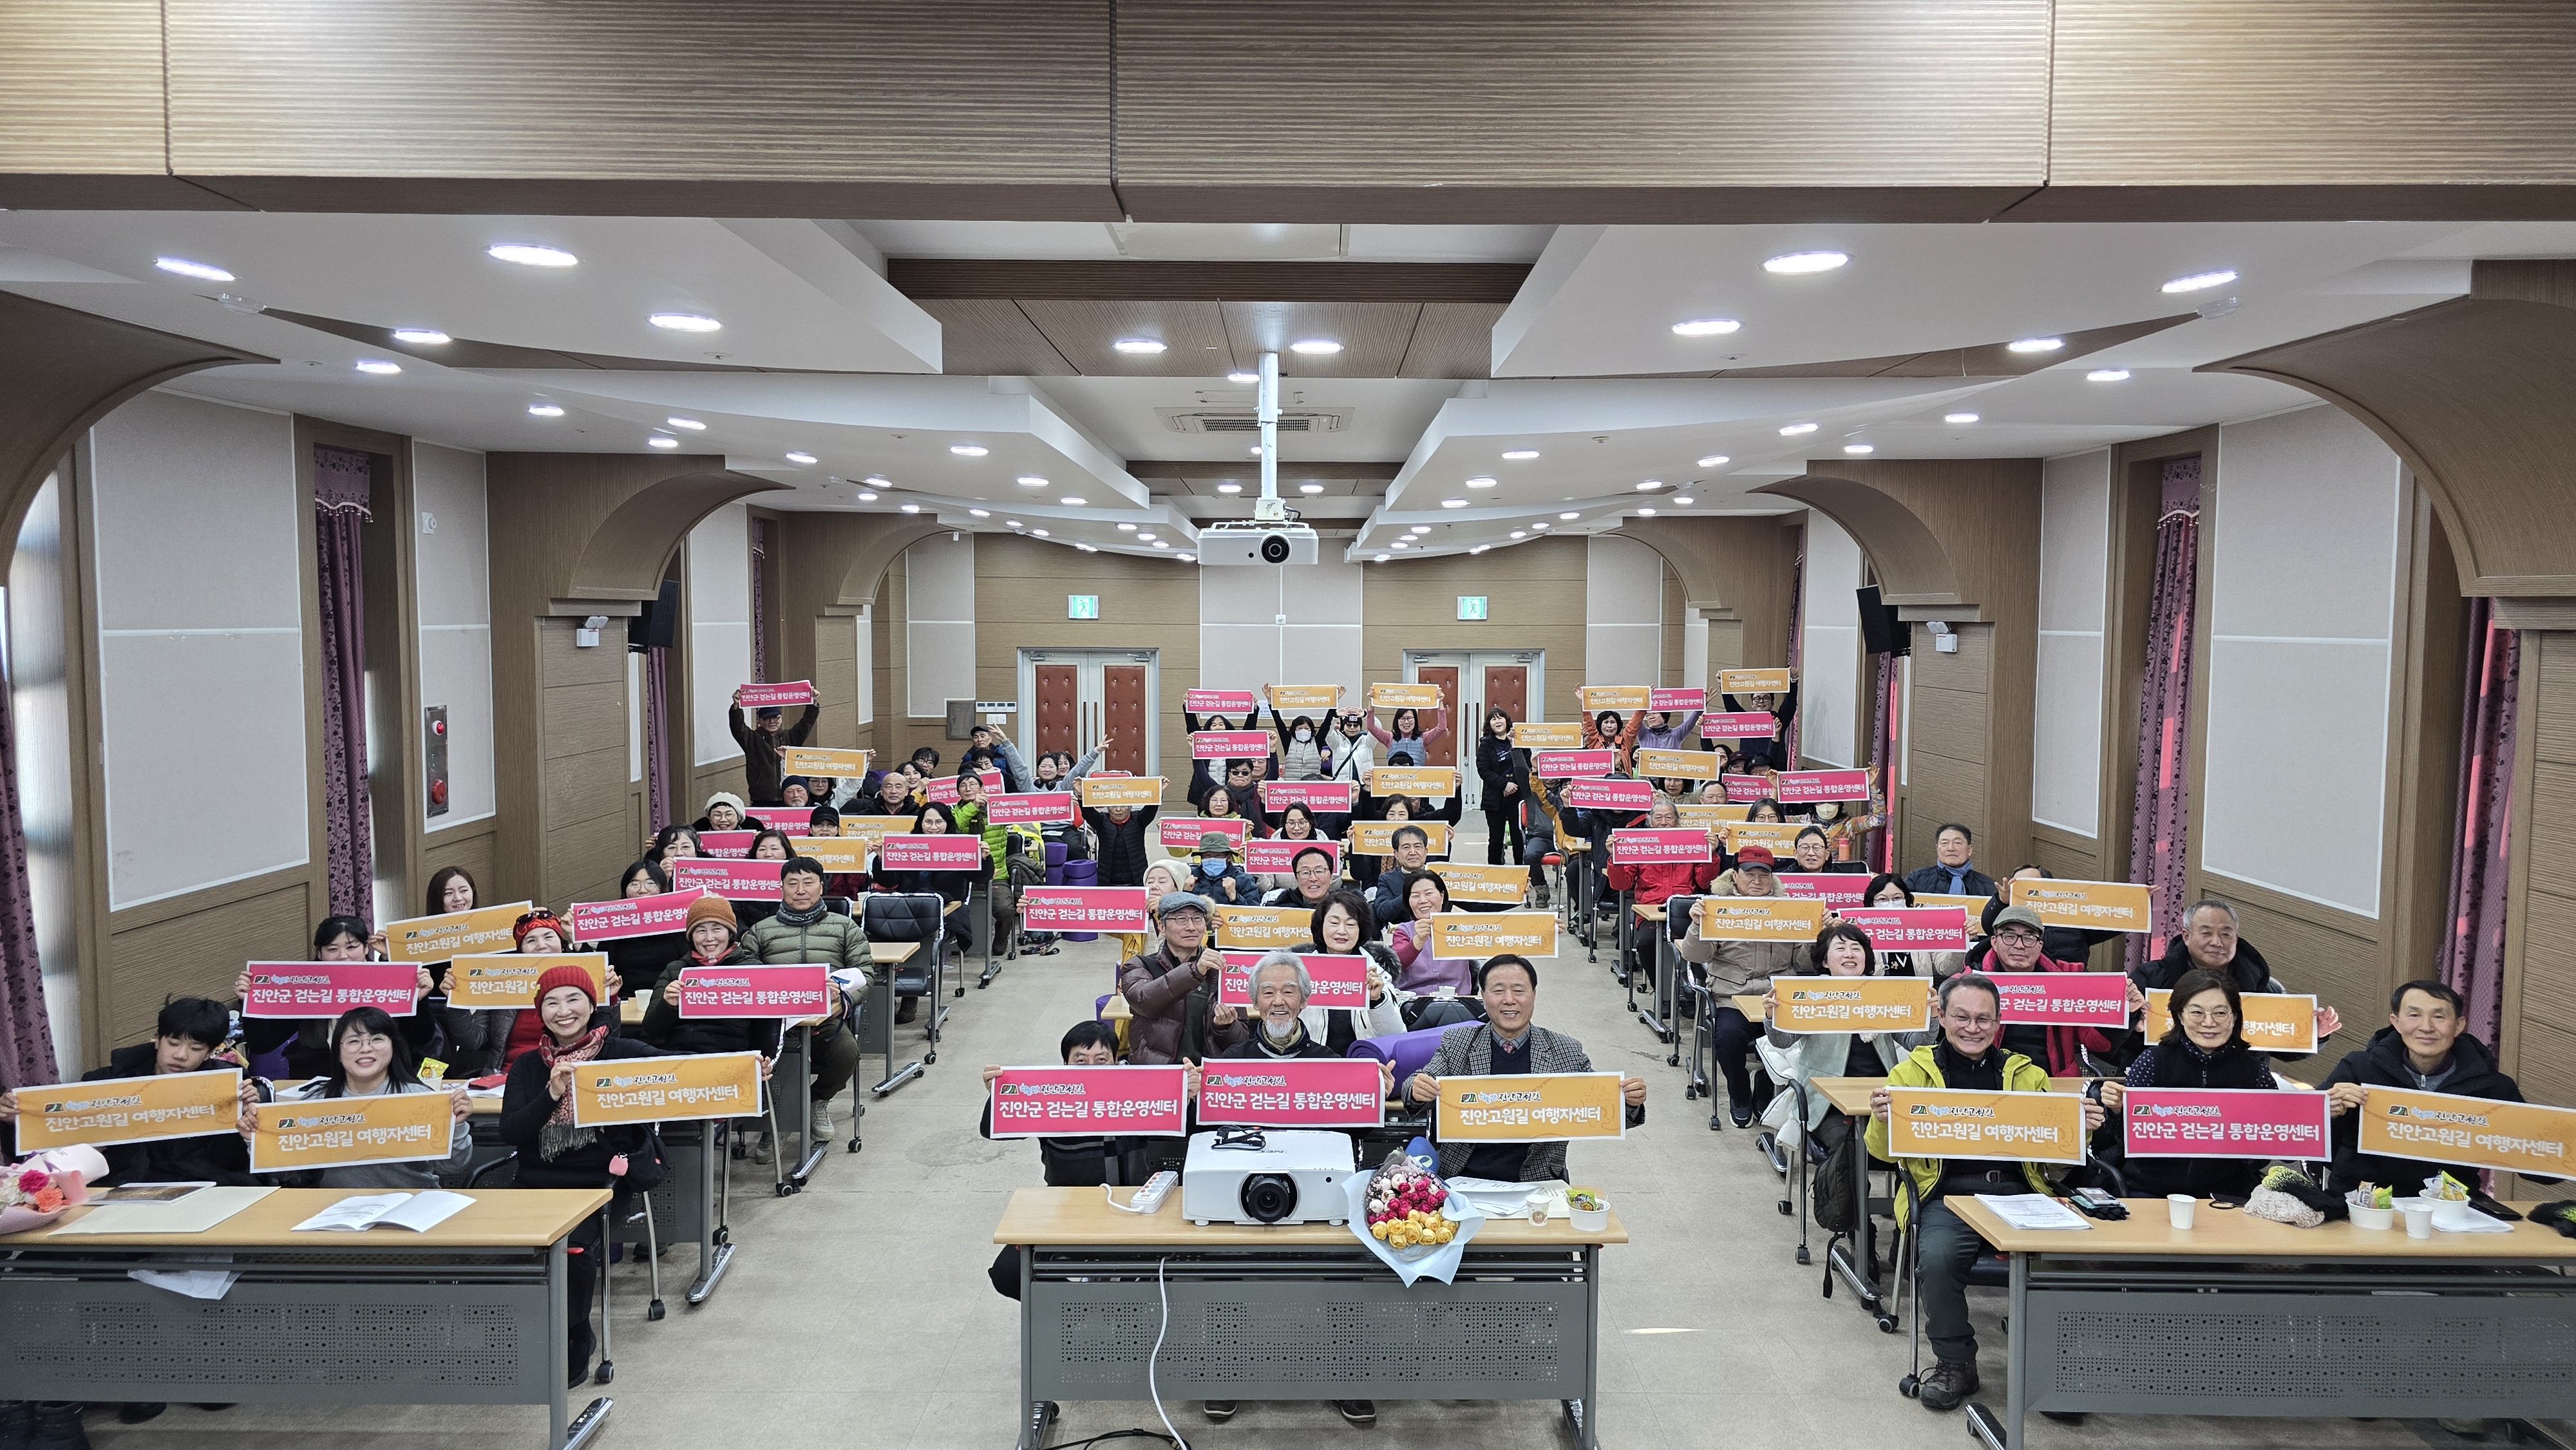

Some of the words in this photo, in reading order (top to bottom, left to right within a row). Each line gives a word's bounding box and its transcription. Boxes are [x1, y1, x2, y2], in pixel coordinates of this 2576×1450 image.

[794, 761, 824, 769] 진안고원길
[1648, 762, 1678, 771] 진안고원길
[930, 791, 948, 800] 진안군
[1092, 791, 1121, 799] 진안고원길
[1781, 786, 1801, 795] 진안군
[1803, 786, 1822, 795] 걷는길
[1823, 784, 1865, 794] 통합운영센터
[1269, 796, 1288, 804] 진안군
[1309, 796, 1347, 804] 통합운영센터
[1571, 791, 1591, 800] 진안군
[1592, 793, 1611, 801] 걷는길
[1611, 794, 1651, 802] 통합운영센터
[990, 807, 1010, 817] 진안군
[1012, 807, 1030, 816] 걷는길
[1031, 805, 1069, 815] 통합운영센터
[774, 822, 810, 831] 통합운영센
[1162, 831, 1182, 839] 진안군
[1364, 838, 1391, 846] 진안고원
[1616, 845, 1639, 855] 진안군
[1640, 845, 1662, 854] 걷는길
[1663, 844, 1707, 854] 통합운영센터
[817, 854, 855, 863] 여행자센터
[886, 852, 908, 861] 진안군
[910, 852, 931, 861] 걷는길
[933, 852, 976, 862] 통합운영센터
[1249, 856, 1269, 865] 진안군
[1271, 856, 1291, 866] 걷는길
[679, 878, 704, 889] 진안군
[706, 879, 730, 890] 걷는길
[1446, 881, 1476, 892] 안고원길
[1477, 882, 1517, 894] 여행자센터
[1028, 908, 1056, 920] 진안군
[1059, 909, 1084, 920] 걷는길
[1087, 909, 1143, 921] 통합운영센터
[2080, 905, 2132, 919] 여행자센터
[577, 917, 609, 931] 진안군
[611, 913, 640, 927] 걷는길
[643, 909, 688, 923] 통합운영
[1714, 918, 1763, 929] 진안고원길
[1763, 919, 1812, 930] 여행자센터
[1229, 927, 1271, 937] 진안고원길
[1876, 928, 1904, 941] 걷는길
[1905, 928, 1963, 941] 통합운영센터
[406, 936, 460, 955] 진안고원길
[1445, 935, 1492, 946] 진안고원길
[1495, 935, 1541, 946] 여행자센터
[469, 979, 529, 994] 진안고원길
[1225, 978, 1249, 992] 진안
[1311, 981, 1362, 995] 합운영센터
[251, 988, 292, 1004] 진안군
[295, 988, 333, 1004] 걷는길
[336, 988, 412, 1003] 통합운영센터
[685, 991, 719, 1004] 진안군
[721, 991, 753, 1004] 걷는길
[755, 990, 823, 1004] 통합운영센터
[1791, 1005, 1849, 1019] 진안고원길
[1852, 1005, 1911, 1019] 여행자센터
[2013, 998, 2047, 1012] 걷는길
[2050, 998, 2121, 1014] 통합운영센터
[2244, 1021, 2295, 1036] 행자센터
[596, 1089, 665, 1109] 진안고원길
[667, 1085, 738, 1104] 여행자센터
[1205, 1091, 1247, 1109] 진안군
[1250, 1092, 1289, 1111] 걷는길
[1293, 1091, 1376, 1111] 통합운영센터
[998, 1100, 1044, 1119] 진안군
[1046, 1100, 1088, 1119] 걷는길
[1092, 1099, 1177, 1118] 통합운영센터
[44, 1111, 128, 1133] 진안고원길
[132, 1104, 214, 1125] 여행자센터
[1459, 1108, 1528, 1125] 진안고원길
[1531, 1107, 1600, 1124] 여행자센터
[277, 1129, 354, 1152] 진안고원길
[357, 1124, 431, 1145] 여행자센터
[1909, 1121, 1981, 1140] 진안고원길
[1984, 1124, 2058, 1144] 여행자센터
[2132, 1121, 2177, 1140] 진안군
[2181, 1122, 2224, 1141] 걷는길
[2228, 1122, 2320, 1142] 통합운영센터
[2387, 1121, 2471, 1148] 진안고원길
[2475, 1134, 2562, 1157] 여행자센터
